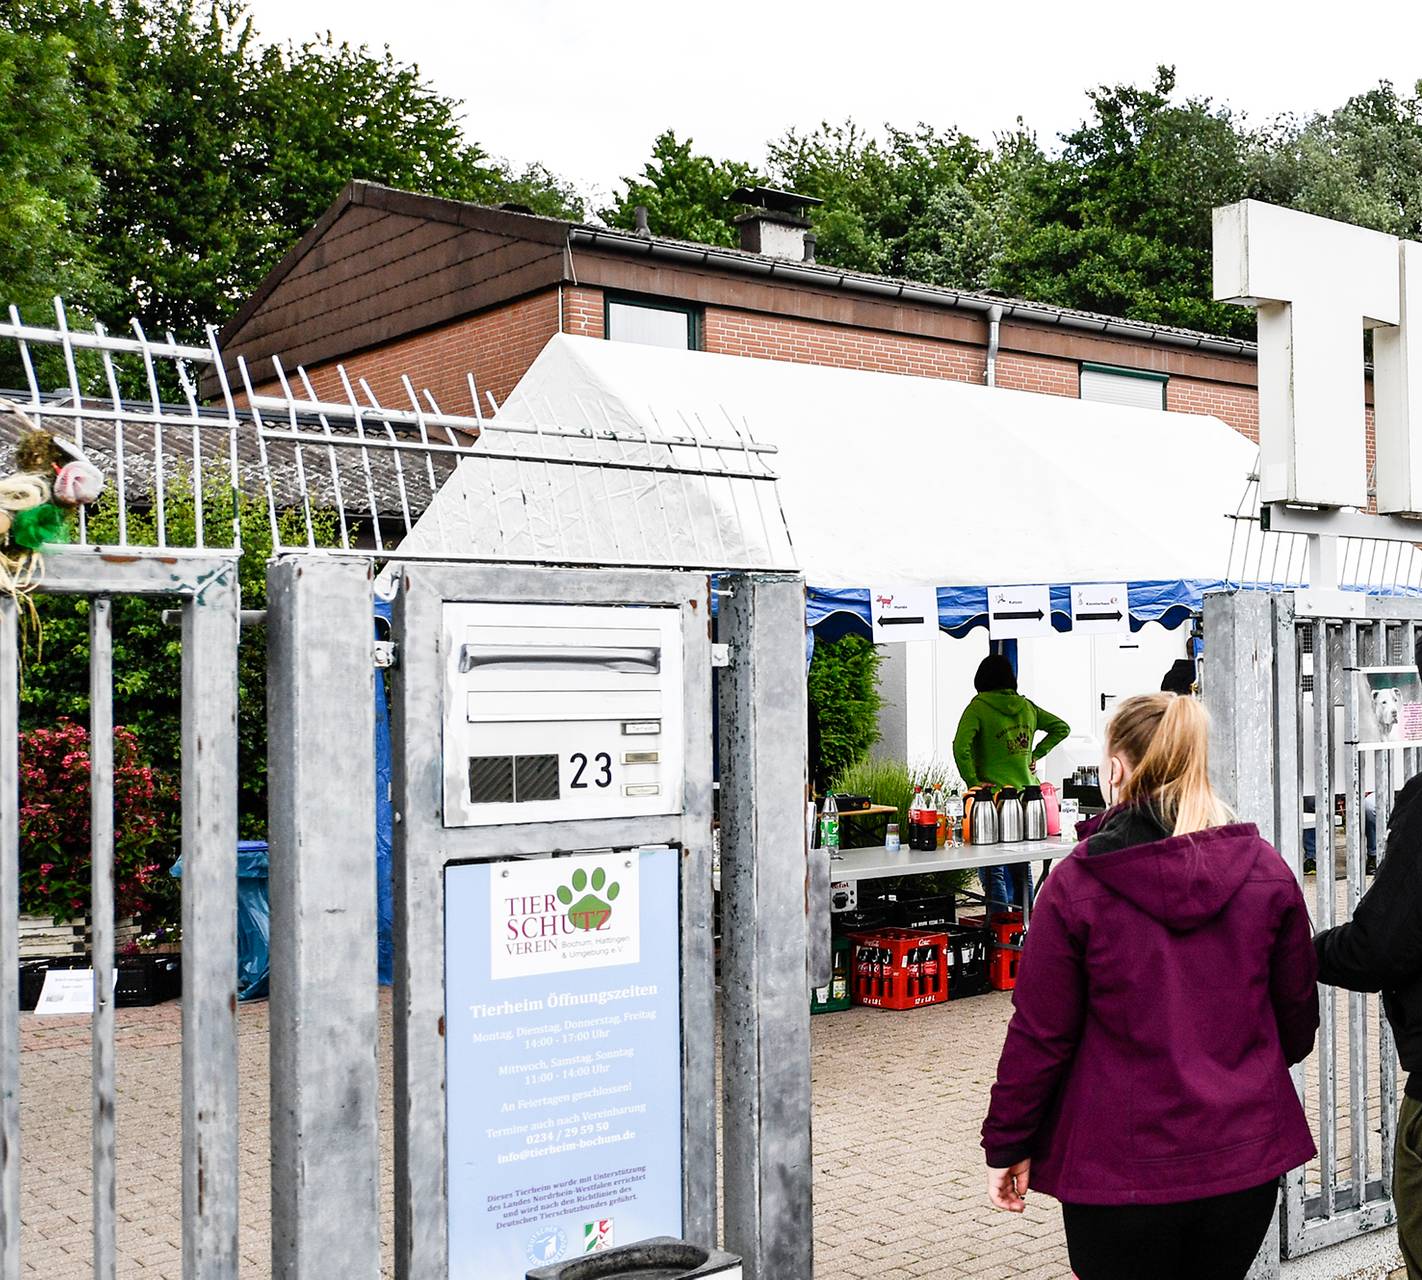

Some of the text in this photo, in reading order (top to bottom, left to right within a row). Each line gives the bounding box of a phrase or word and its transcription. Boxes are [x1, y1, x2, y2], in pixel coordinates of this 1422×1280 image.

[570, 752, 612, 789] 23
[504, 894, 557, 917] TIER
[506, 909, 611, 941] SCHUTZ
[505, 938, 558, 956] VEREIN
[469, 984, 658, 1018] Tierheim Öffnungszeiten
[472, 1029, 514, 1043] Montag,
[516, 1023, 562, 1038] Dienstag,
[623, 1008, 657, 1022] Freitag
[525, 1037, 553, 1049] 14:00
[562, 1032, 590, 1044] 17:00
[592, 1028, 611, 1039] Uhr
[595, 1047, 634, 1062] Sonntag
[525, 1073, 553, 1085] 11:00
[562, 1068, 590, 1080] 14:00
[592, 1063, 611, 1075] Uhr
[501, 1082, 632, 1113] An Feiertagen geschlossen!
[486, 1103, 646, 1139] Termine auch nach Vereinbarung
[526, 1121, 610, 1145] 0234 / 29 59 50
[497, 1129, 636, 1164] info@tierheim-bochum.de
[487, 1192, 514, 1203] Dieses
[515, 1184, 551, 1197] Tierheim
[553, 1178, 577, 1190] wurde
[579, 1174, 592, 1184] mit
[487, 1173, 647, 1213] des Landes Nordrhein-Westfalen errichtet
[503, 1186, 632, 1219] und wird nach den Richtlinien des
[496, 1215, 538, 1230] Deutschen
[540, 1199, 608, 1221] Tierschutzbundes
